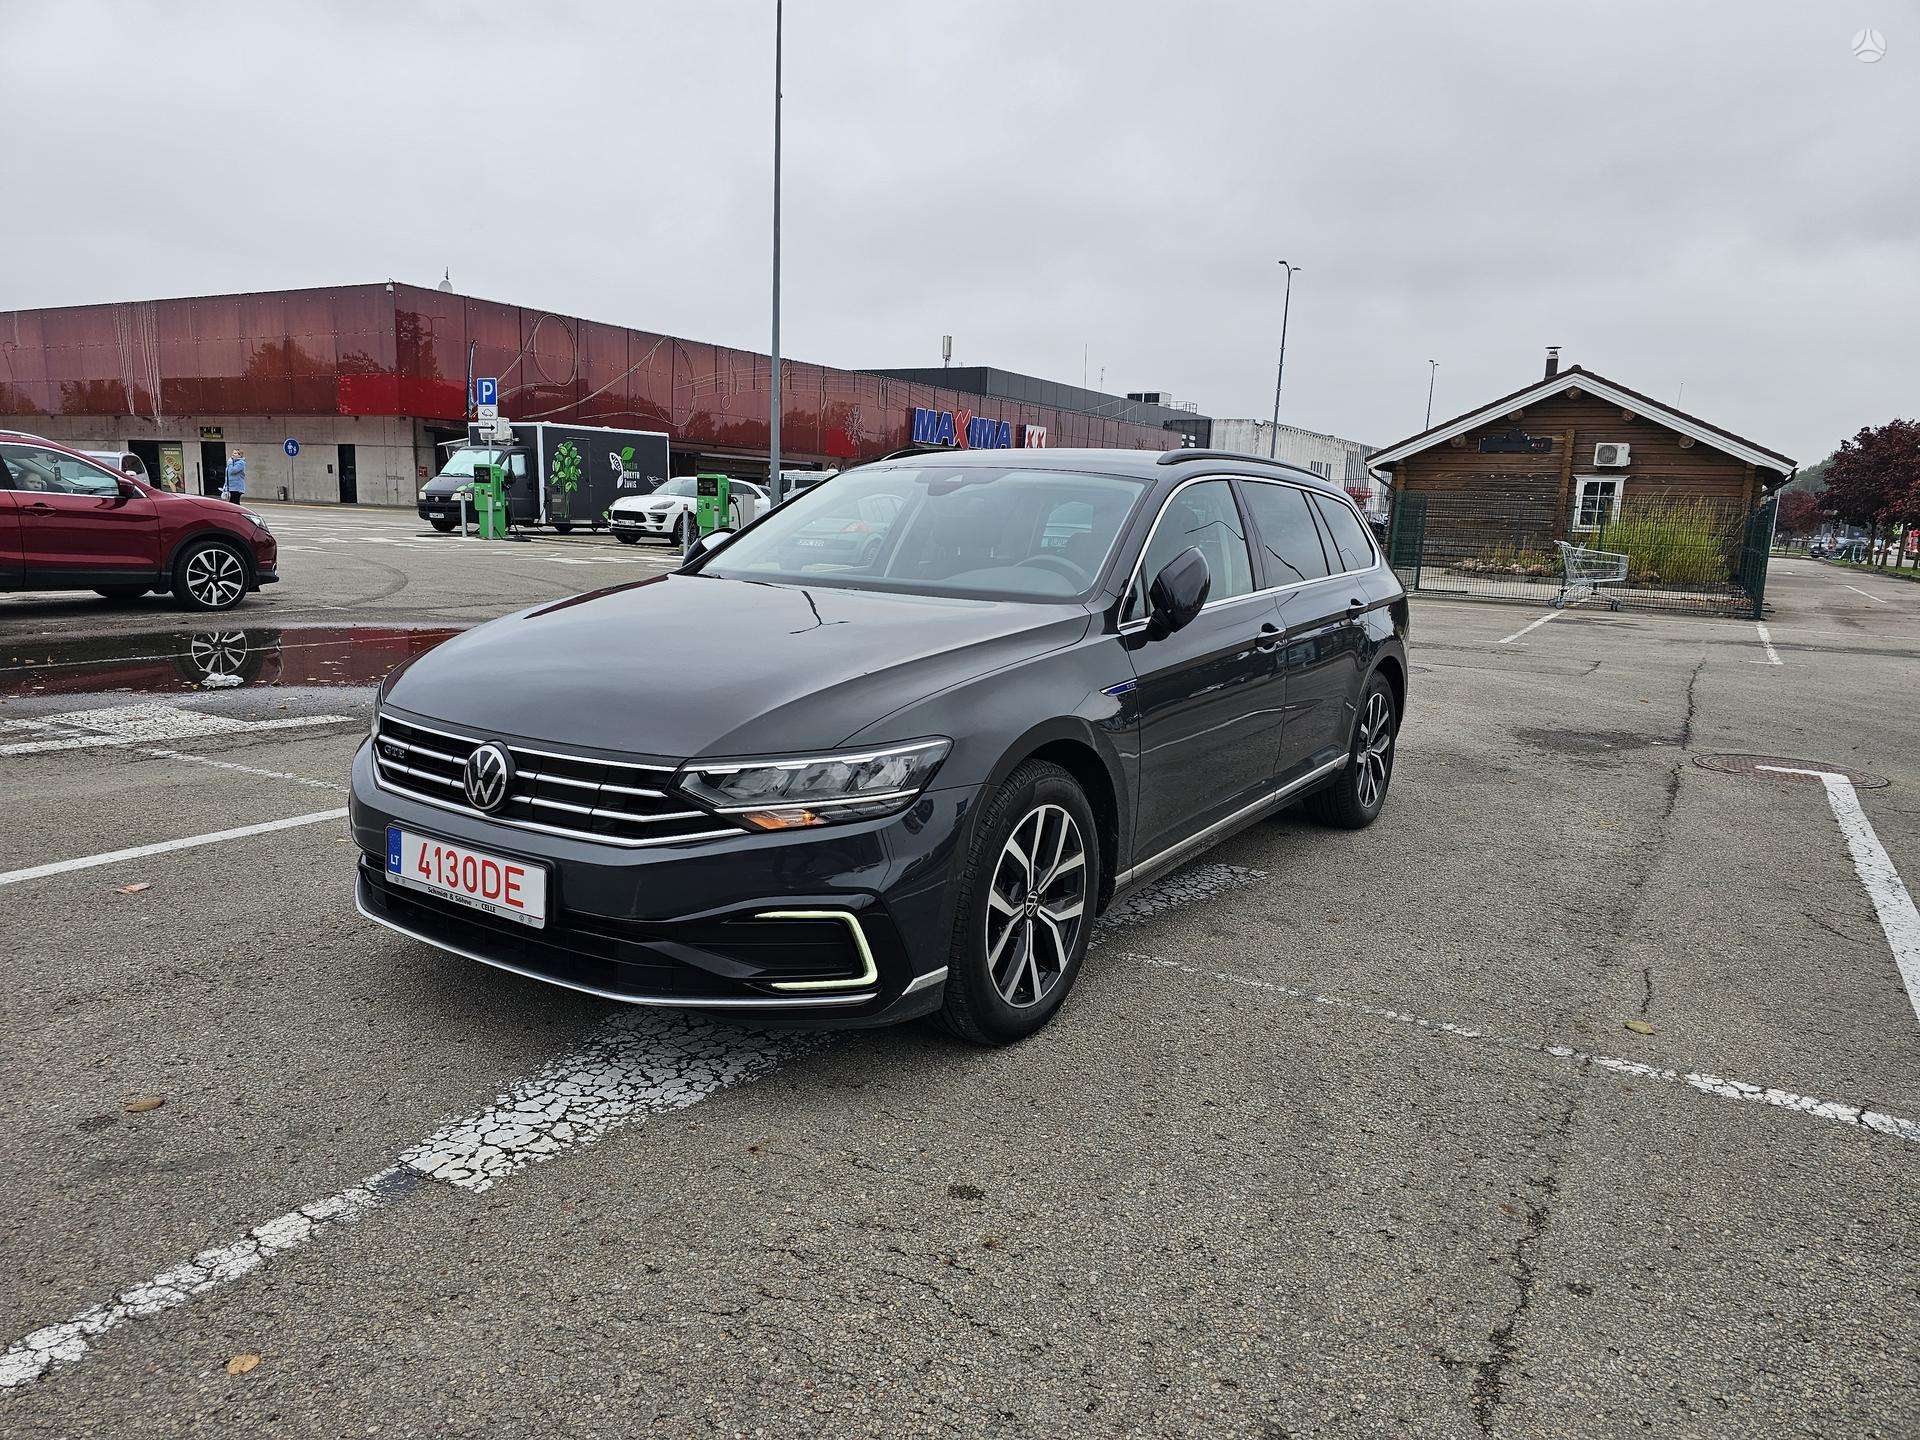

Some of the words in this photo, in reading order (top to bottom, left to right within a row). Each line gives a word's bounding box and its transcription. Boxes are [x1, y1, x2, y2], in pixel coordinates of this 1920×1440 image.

[482, 381, 493, 403] P
[913, 407, 1012, 448] MAXIMA
[390, 854, 400, 866] LT
[417, 842, 524, 908] 4130DE
[427, 886, 448, 898] Schmidt
[481, 903, 496, 913] CELLE
